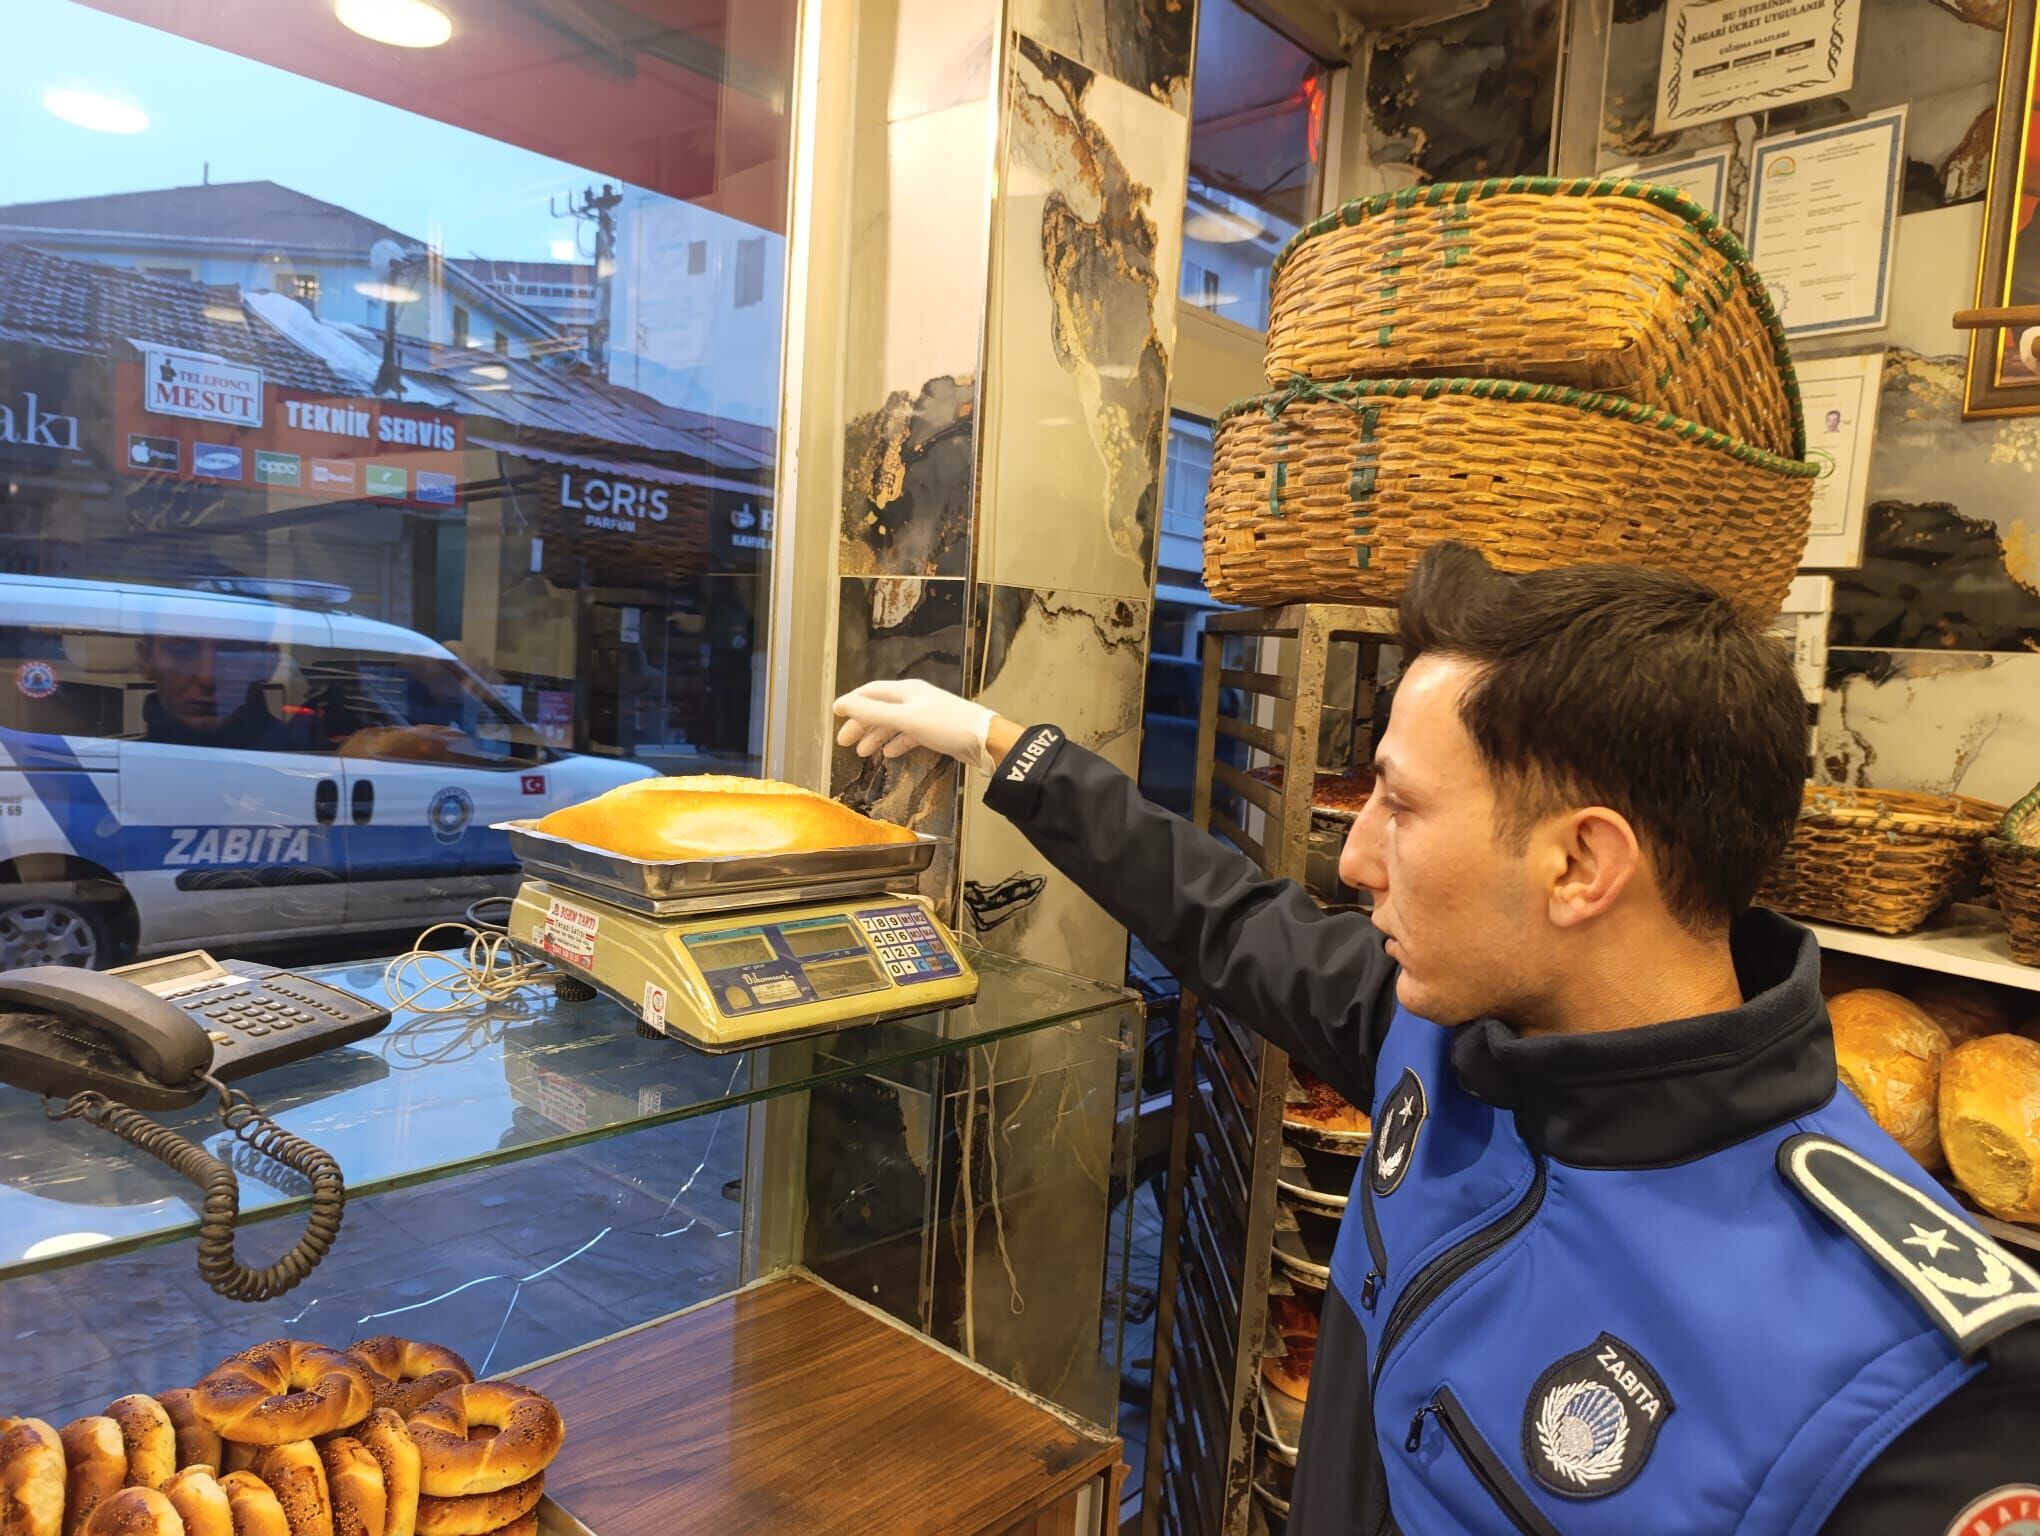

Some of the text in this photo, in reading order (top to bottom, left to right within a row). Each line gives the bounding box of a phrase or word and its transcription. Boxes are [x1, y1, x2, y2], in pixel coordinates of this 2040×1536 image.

[1722, 10, 1736, 23] BU
[1690, 25, 1727, 45] ASGARİ
[1728, 17, 1762, 34] ÜCRET
[180, 370, 255, 392] TELEFONCU
[155, 382, 255, 417] MESUT
[285, 399, 456, 452] TEKNİK SERVİS
[1006, 729, 1059, 782] ZABITA
[163, 828, 309, 865] ZABITA
[863, 920, 871, 929] 7
[876, 918, 886, 928] 8
[889, 916, 898, 926] 9
[873, 935, 882, 944] 4
[886, 933, 895, 943] 5
[898, 931, 908, 941] 6
[883, 946, 917, 959] 1 2 3
[891, 965, 900, 974] 0
[1596, 1345, 1661, 1421] ZABITA
